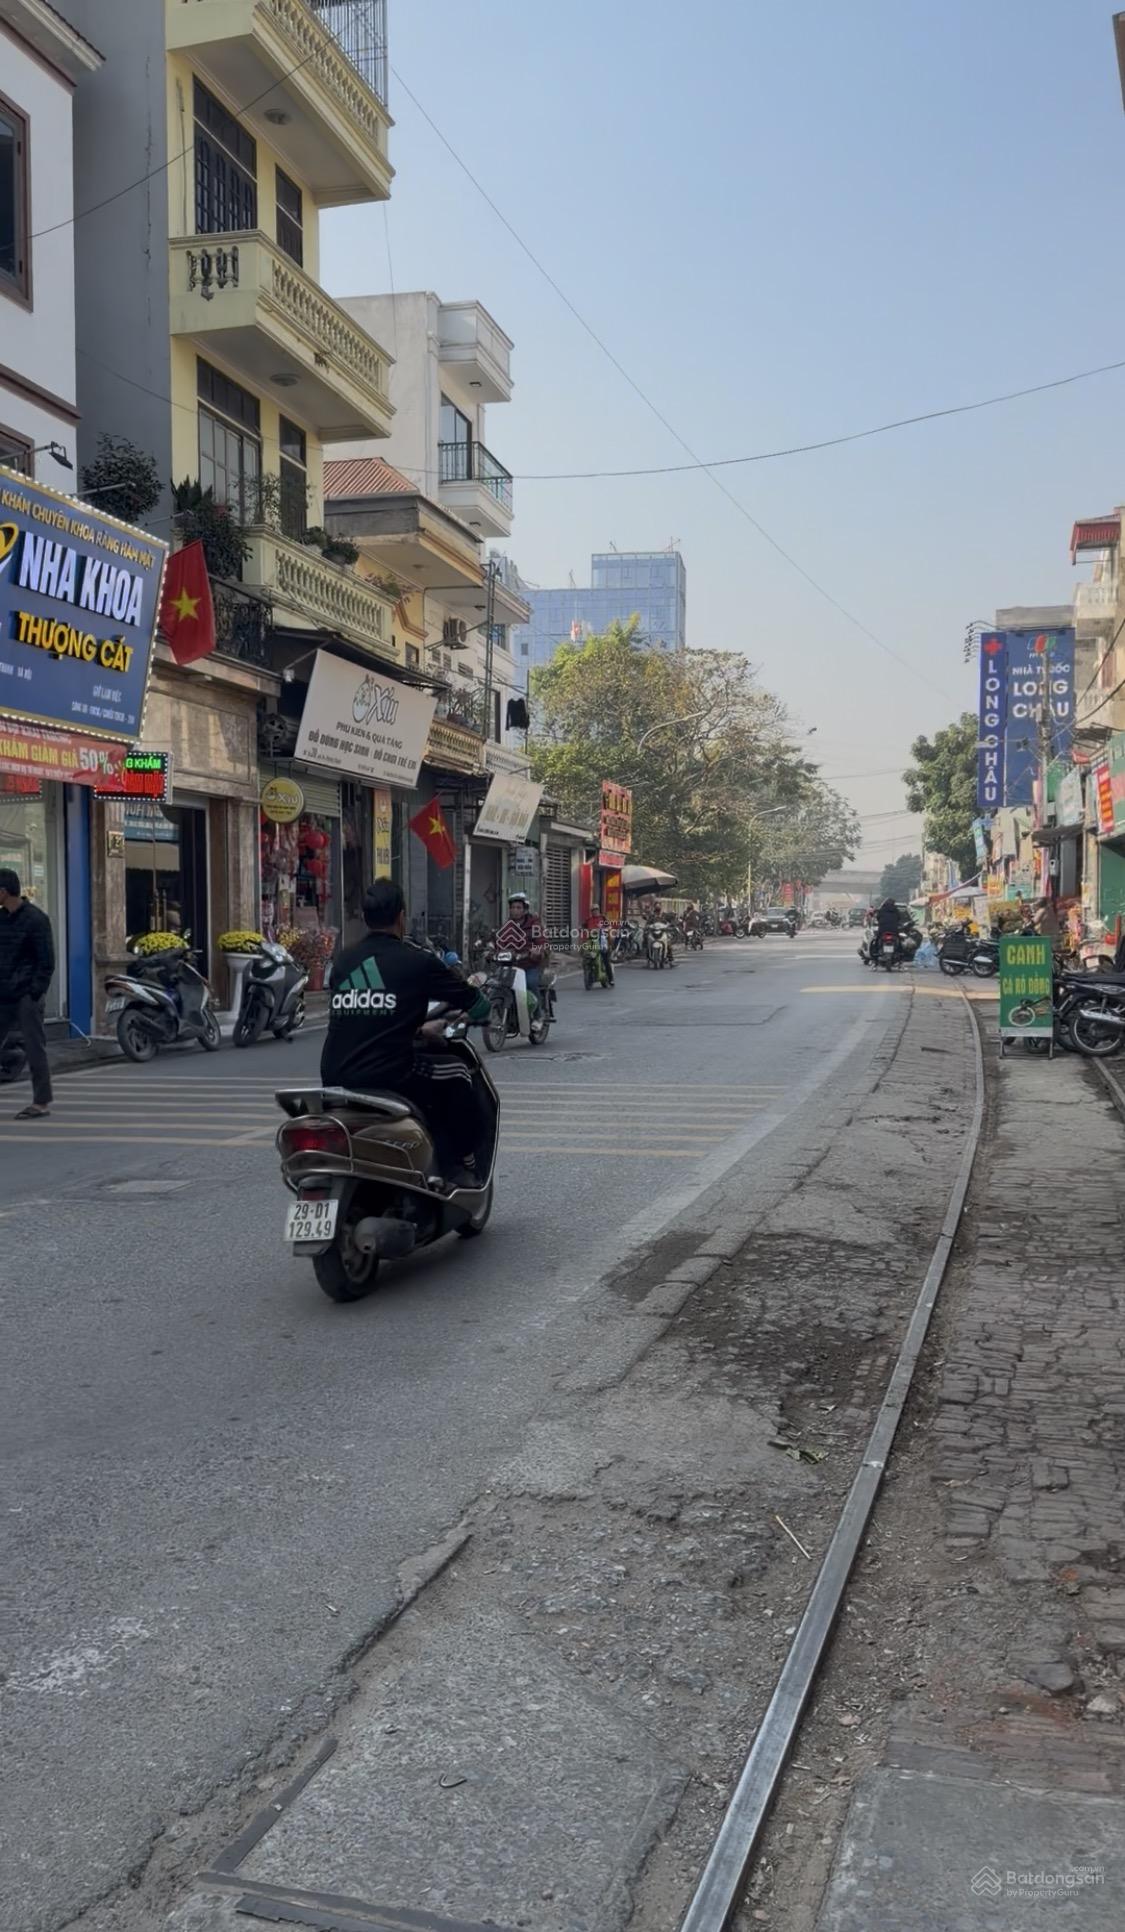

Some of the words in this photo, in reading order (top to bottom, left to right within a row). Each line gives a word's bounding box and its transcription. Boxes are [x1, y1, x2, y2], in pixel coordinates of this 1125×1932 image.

[2, 489, 31, 517] KHÁM
[32, 503, 70, 532] CHUYÊN
[71, 519, 95, 544] KHOA
[96, 528, 119, 555] RĂNG
[19, 531, 77, 603] NHA
[79, 556, 144, 627] KHOA
[19, 611, 97, 661] THƯỢNG
[100, 636, 134, 672] CÁT
[1012, 664, 1033, 675] NHÀ
[984, 659, 1000, 728] LONG
[31, 741, 58, 766] GIẢM
[61, 747, 79, 768] GIÁ
[79, 747, 114, 775] 50%
[135, 757, 161, 769] KHÁM
[984, 735, 1000, 801] CHÂU
[1007, 944, 1045, 965] CANH
[332, 988, 396, 1009] adidas
[289, 1220, 332, 1238] 129.49
